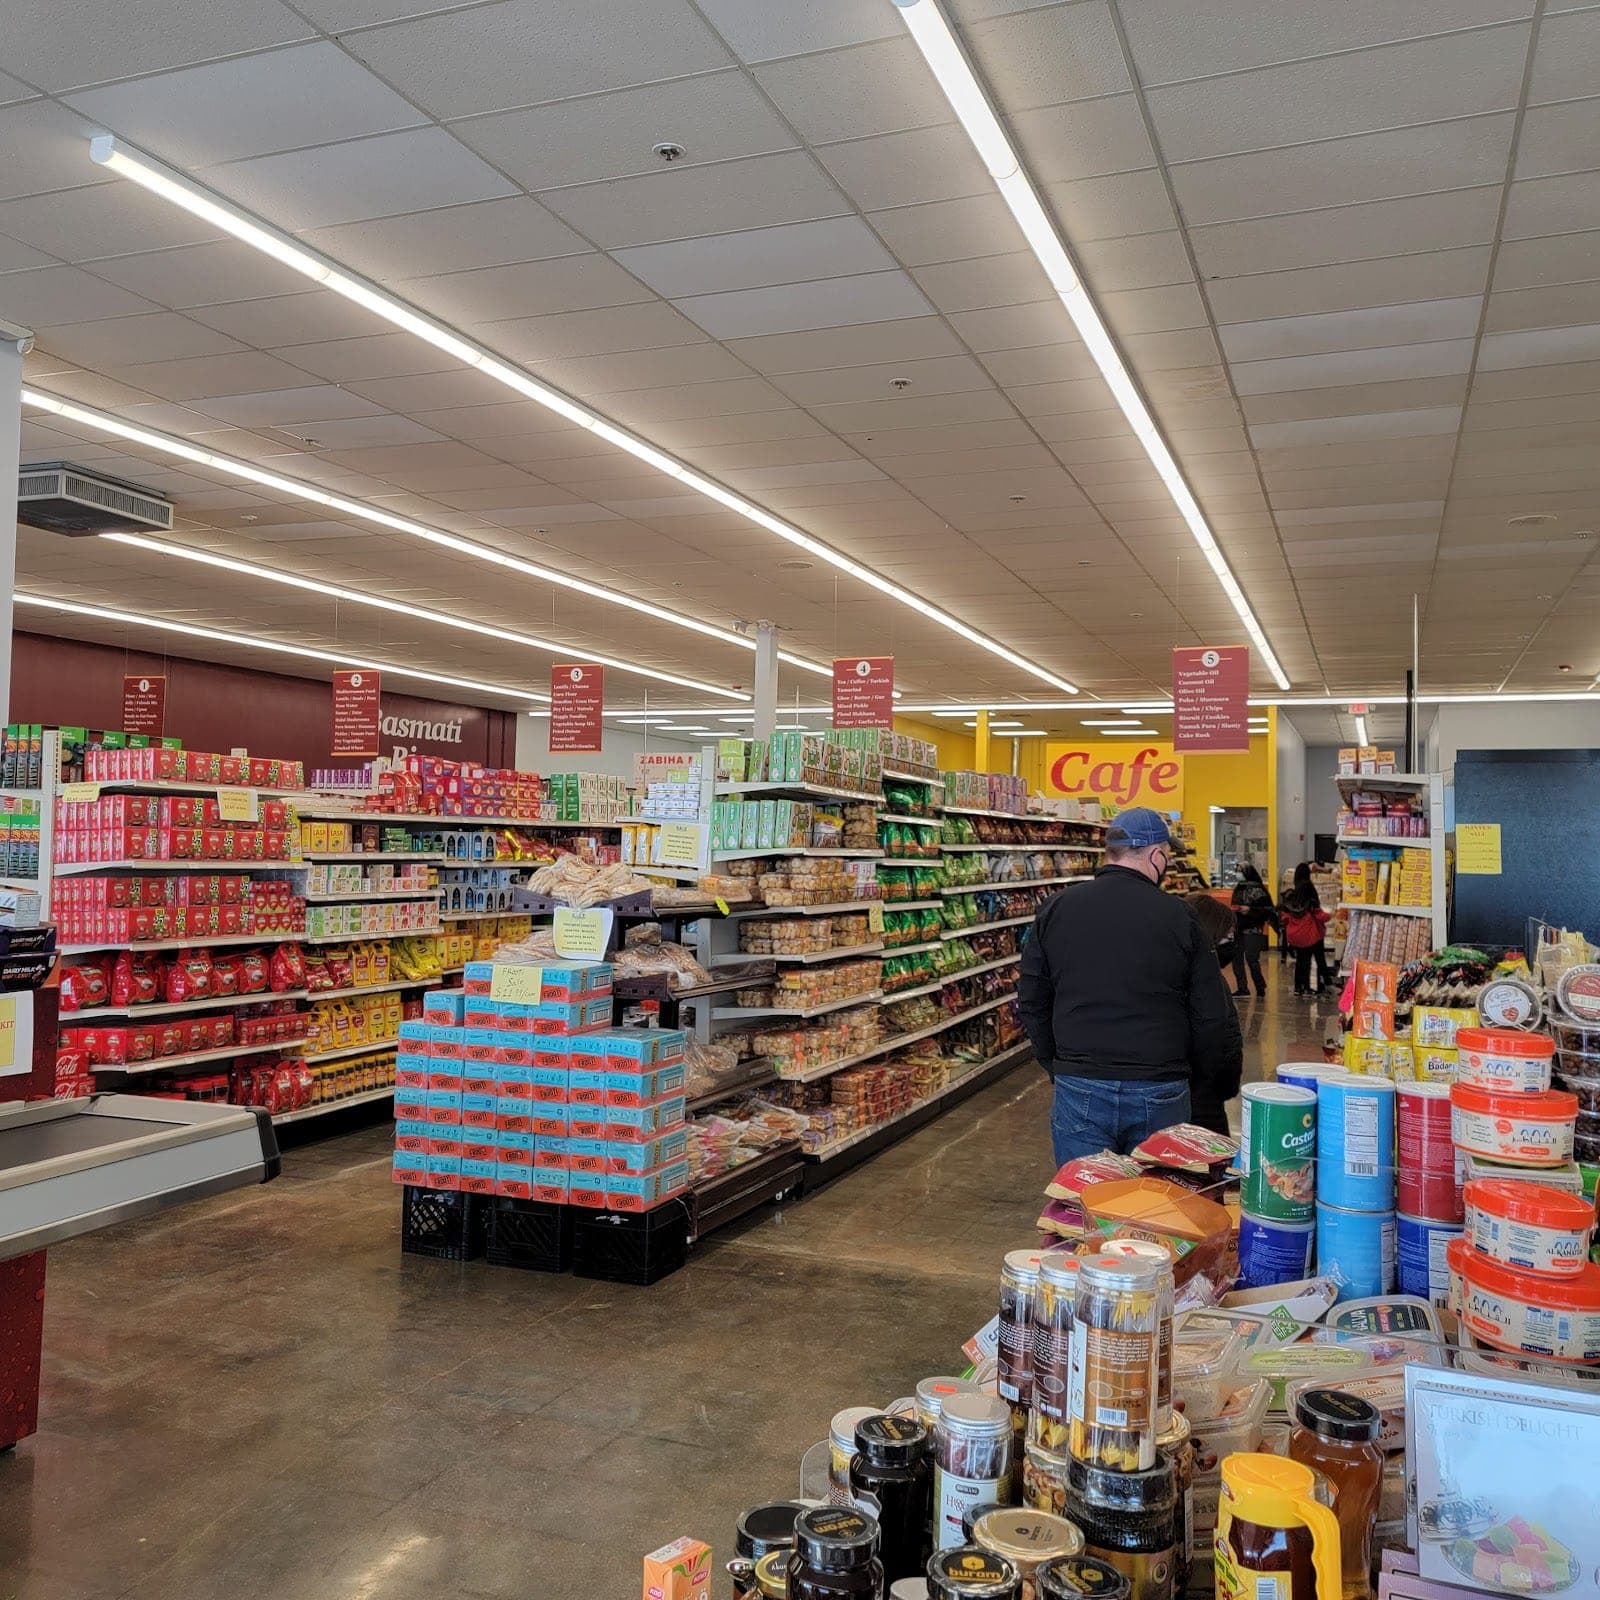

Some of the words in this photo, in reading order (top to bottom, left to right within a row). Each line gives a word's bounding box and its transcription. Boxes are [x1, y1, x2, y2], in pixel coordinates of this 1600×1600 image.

[1207, 654, 1215, 664] 5
[860, 664, 866, 674] 4
[1178, 670, 1208, 678] Vegetable
[354, 676, 360, 684] 2
[378, 710, 462, 744] asmati
[640, 756, 684, 765] ZABIHA
[1050, 748, 1180, 806] Cafe
[0, 1020, 14, 1030] KIT
[1428, 1404, 1499, 1428] TURKISH
[1505, 1416, 1585, 1440] DELIGHT
[814, 1516, 864, 1534] buram
[949, 1567, 1002, 1579] buram
